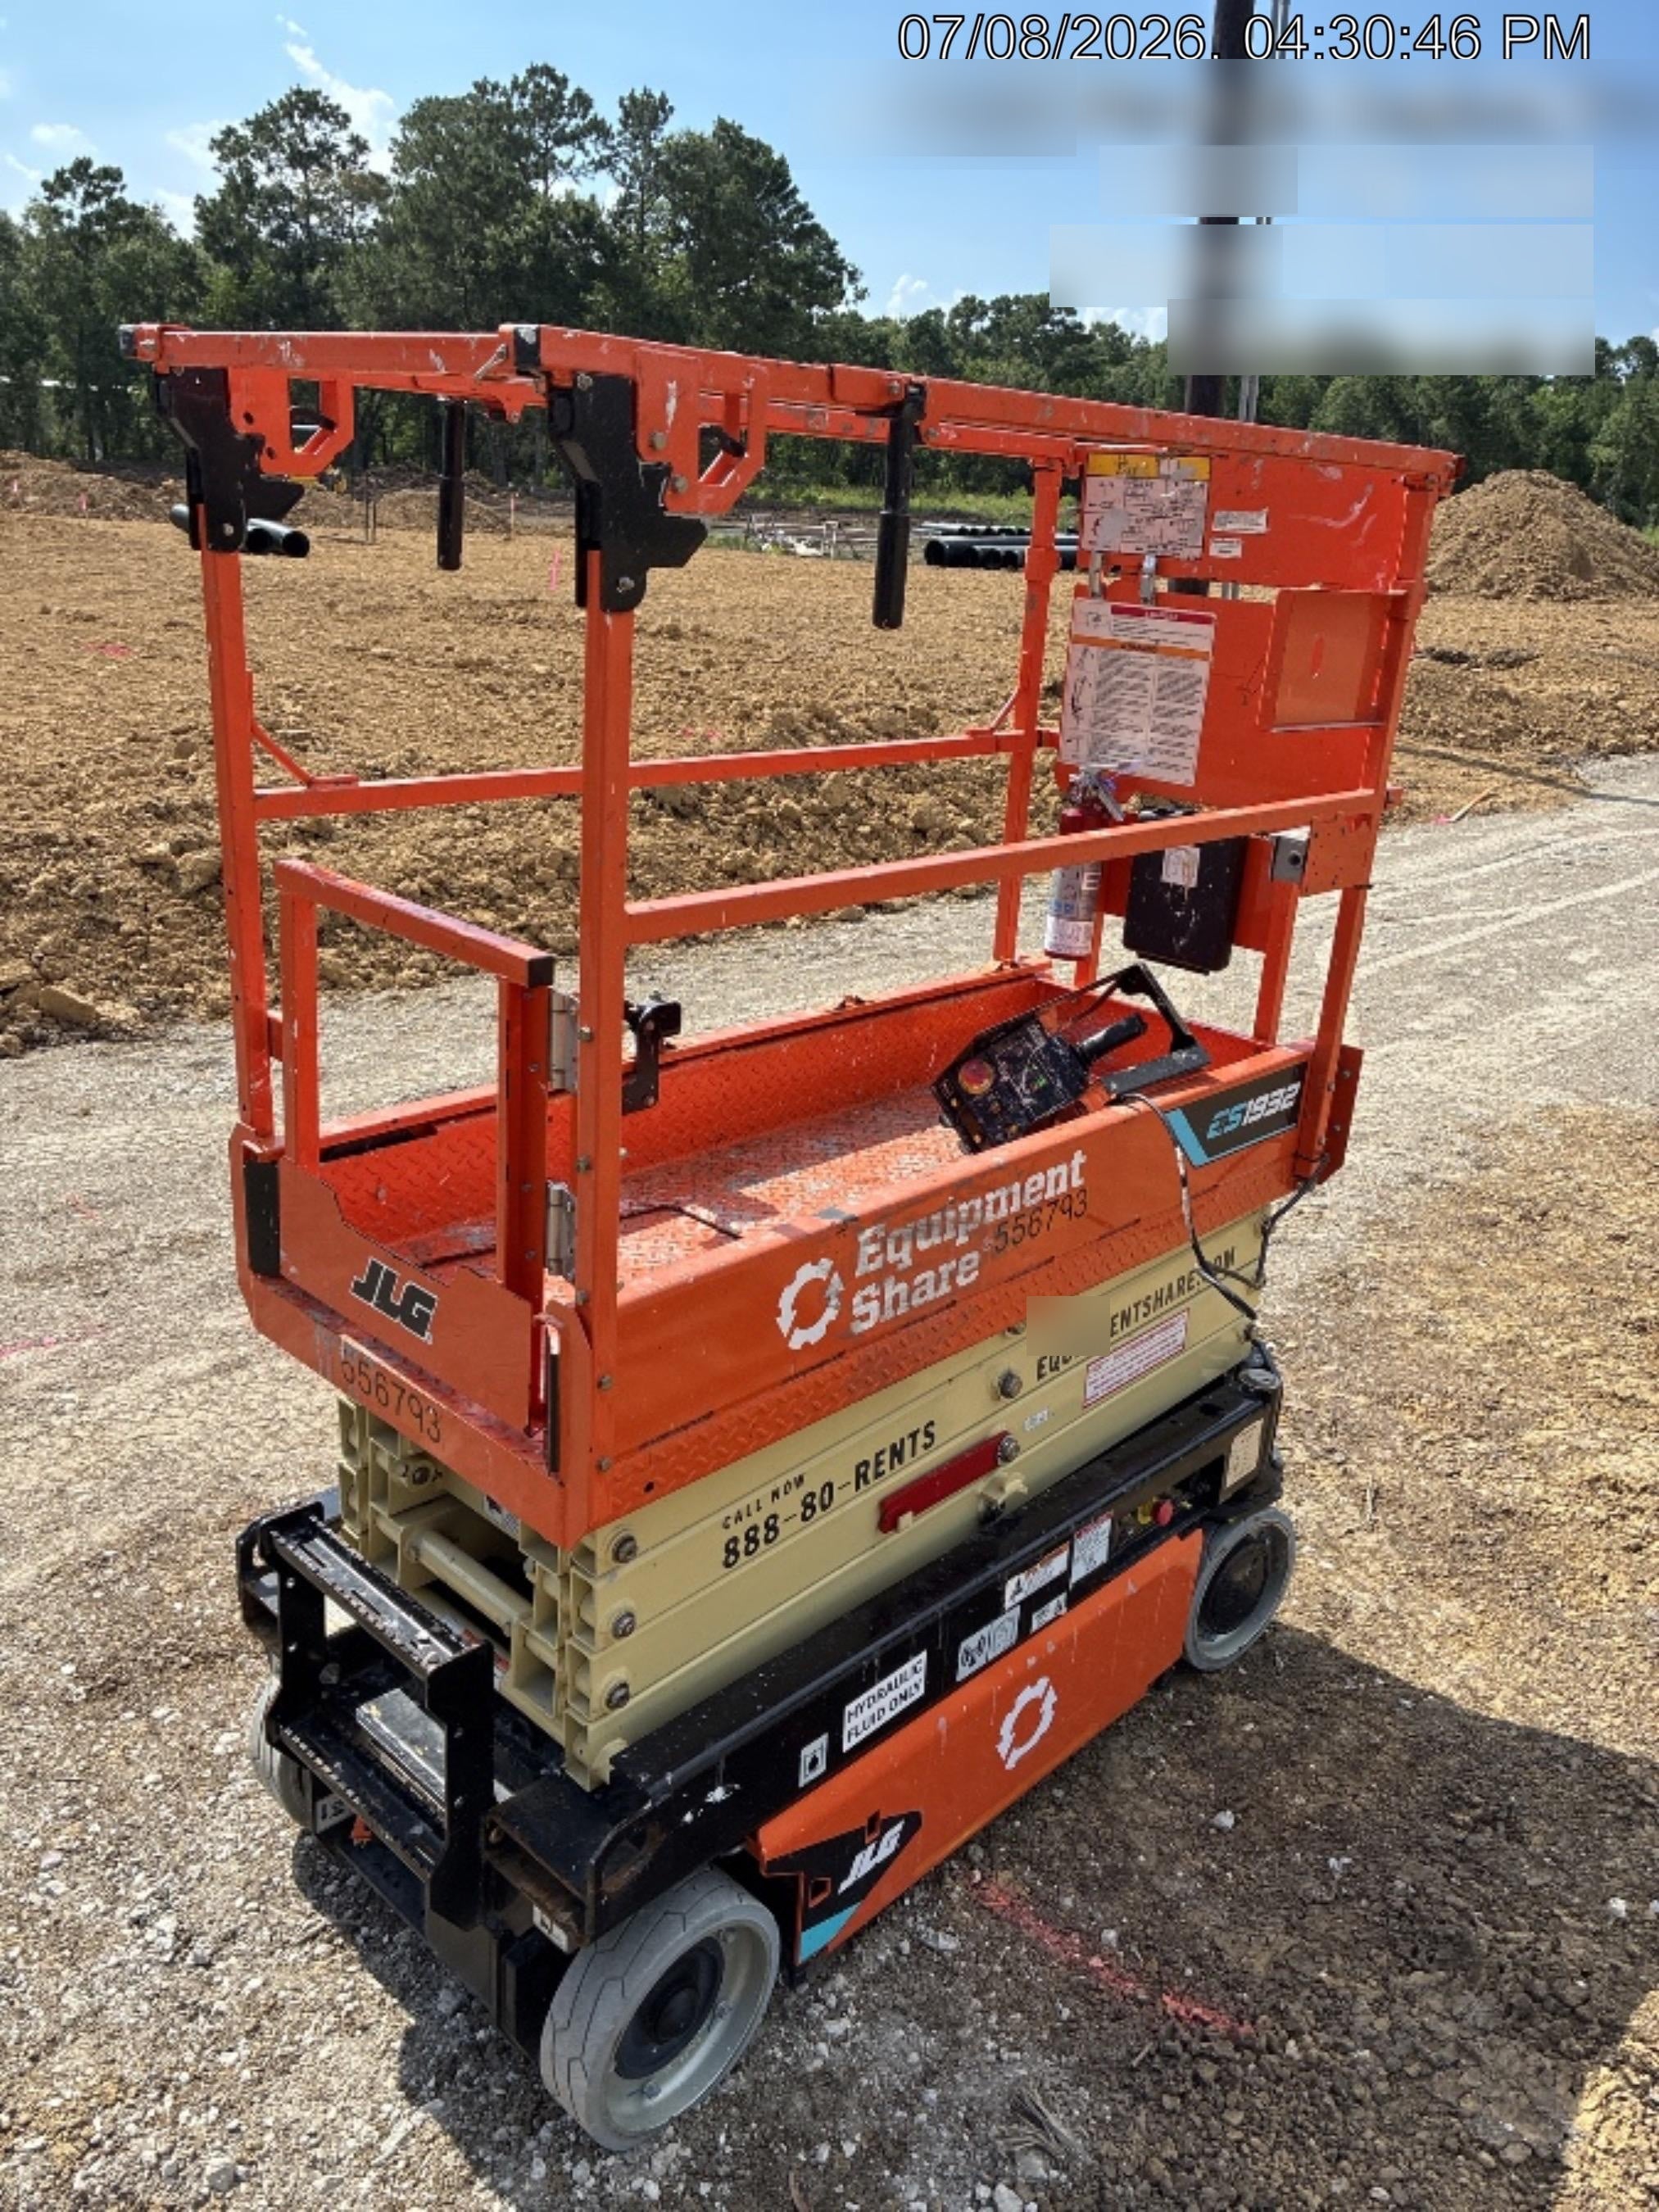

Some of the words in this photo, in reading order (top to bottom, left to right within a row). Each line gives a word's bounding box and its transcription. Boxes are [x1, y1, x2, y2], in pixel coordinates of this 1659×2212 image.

[854, 1149, 1087, 1278] Equipment
[993, 1189, 1088, 1253] 556793
[351, 1258, 439, 1342] JLG
[850, 1250, 981, 1335] Share
[723, 1421, 936, 1569] 888-80-RENTS
[723, 1499, 763, 1530] CALL
[771, 1474, 805, 1504] NOW
[847, 1707, 886, 1743] FLUID
[889, 1679, 922, 1712] ONLY
[837, 1819, 905, 1896] JLG
